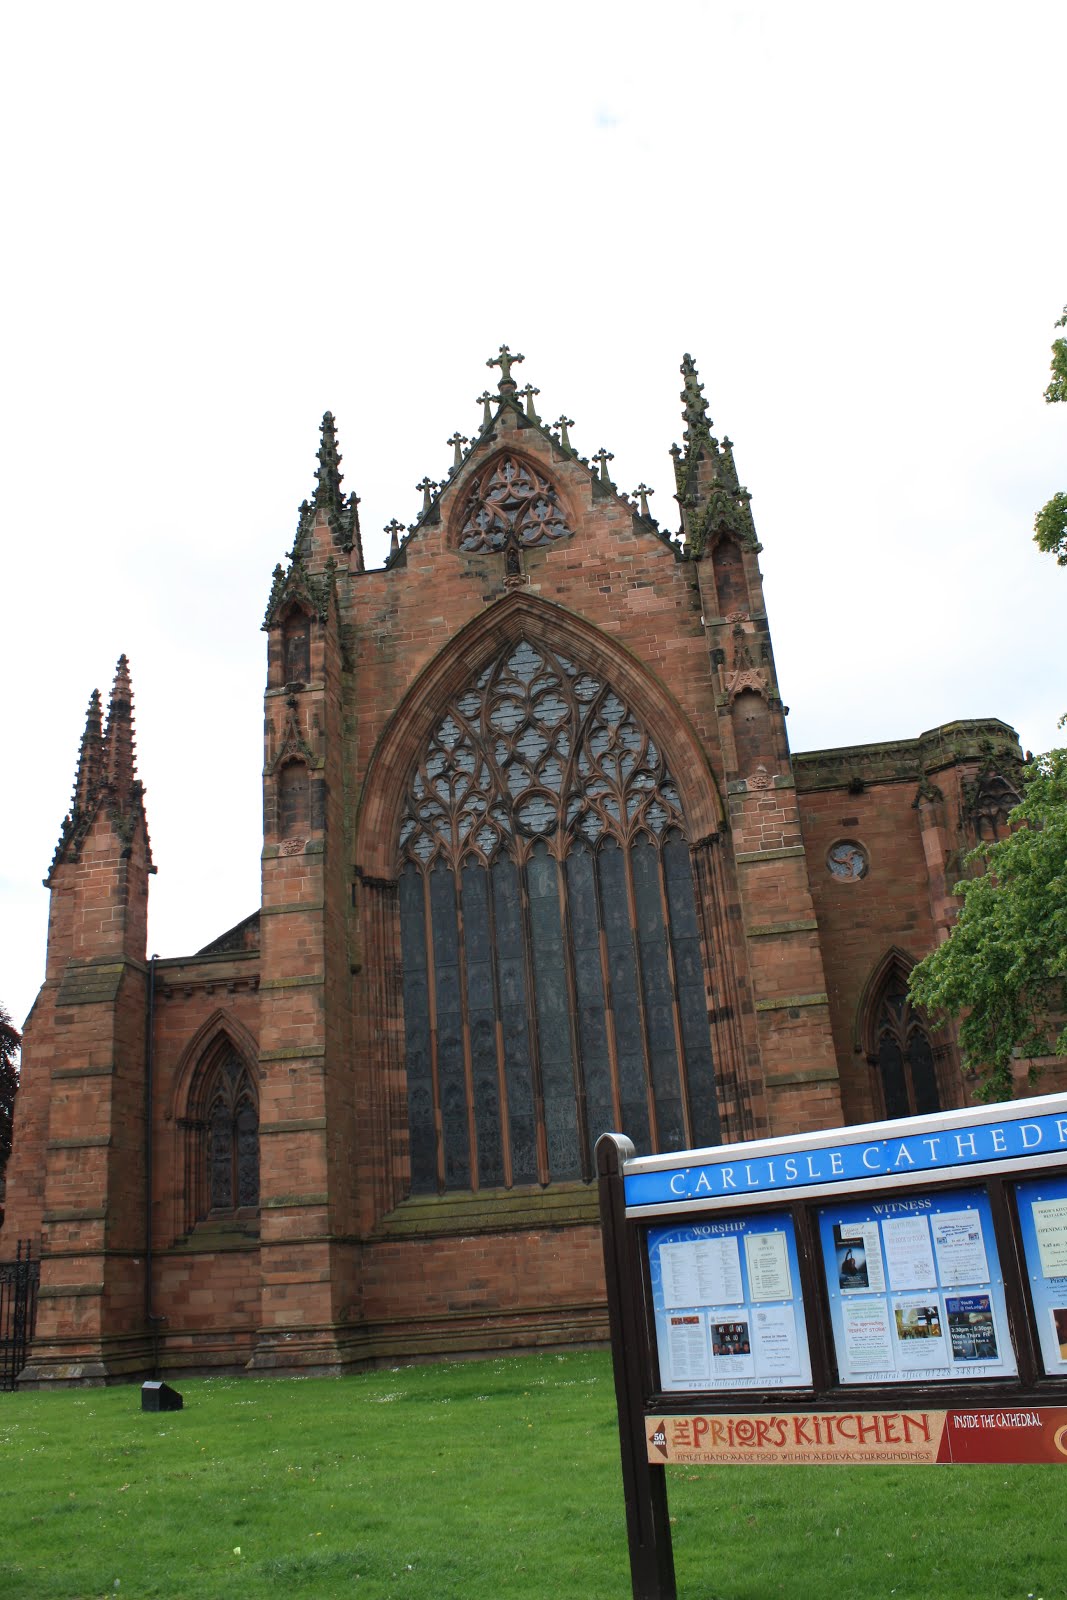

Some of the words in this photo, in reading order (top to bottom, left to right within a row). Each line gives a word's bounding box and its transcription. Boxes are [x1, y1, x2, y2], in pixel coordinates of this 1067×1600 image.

[670, 1152, 845, 1194] CARLISLE
[872, 1199, 932, 1214] WITNESS
[692, 1222, 746, 1236] WORSHIP
[925, 1368, 951, 1377] 01228
[953, 1414, 979, 1428] INSIDE
[980, 1413, 996, 1428] THE
[996, 1411, 1043, 1427] CATHEDRAL
[653, 1432, 665, 1441] 50
[672, 1418, 692, 1447] THE
[691, 1416, 788, 1448] PRIOR'S
[792, 1413, 932, 1446] KITCHEN
[677, 1453, 701, 1461] FINEST
[703, 1453, 754, 1461] HAND-MADE
[756, 1453, 779, 1461] FOOD
[781, 1453, 810, 1461] WITHIN
[813, 1453, 856, 1461] MEDIEVAL
[860, 1452, 930, 1461] SURROUNDINGS
